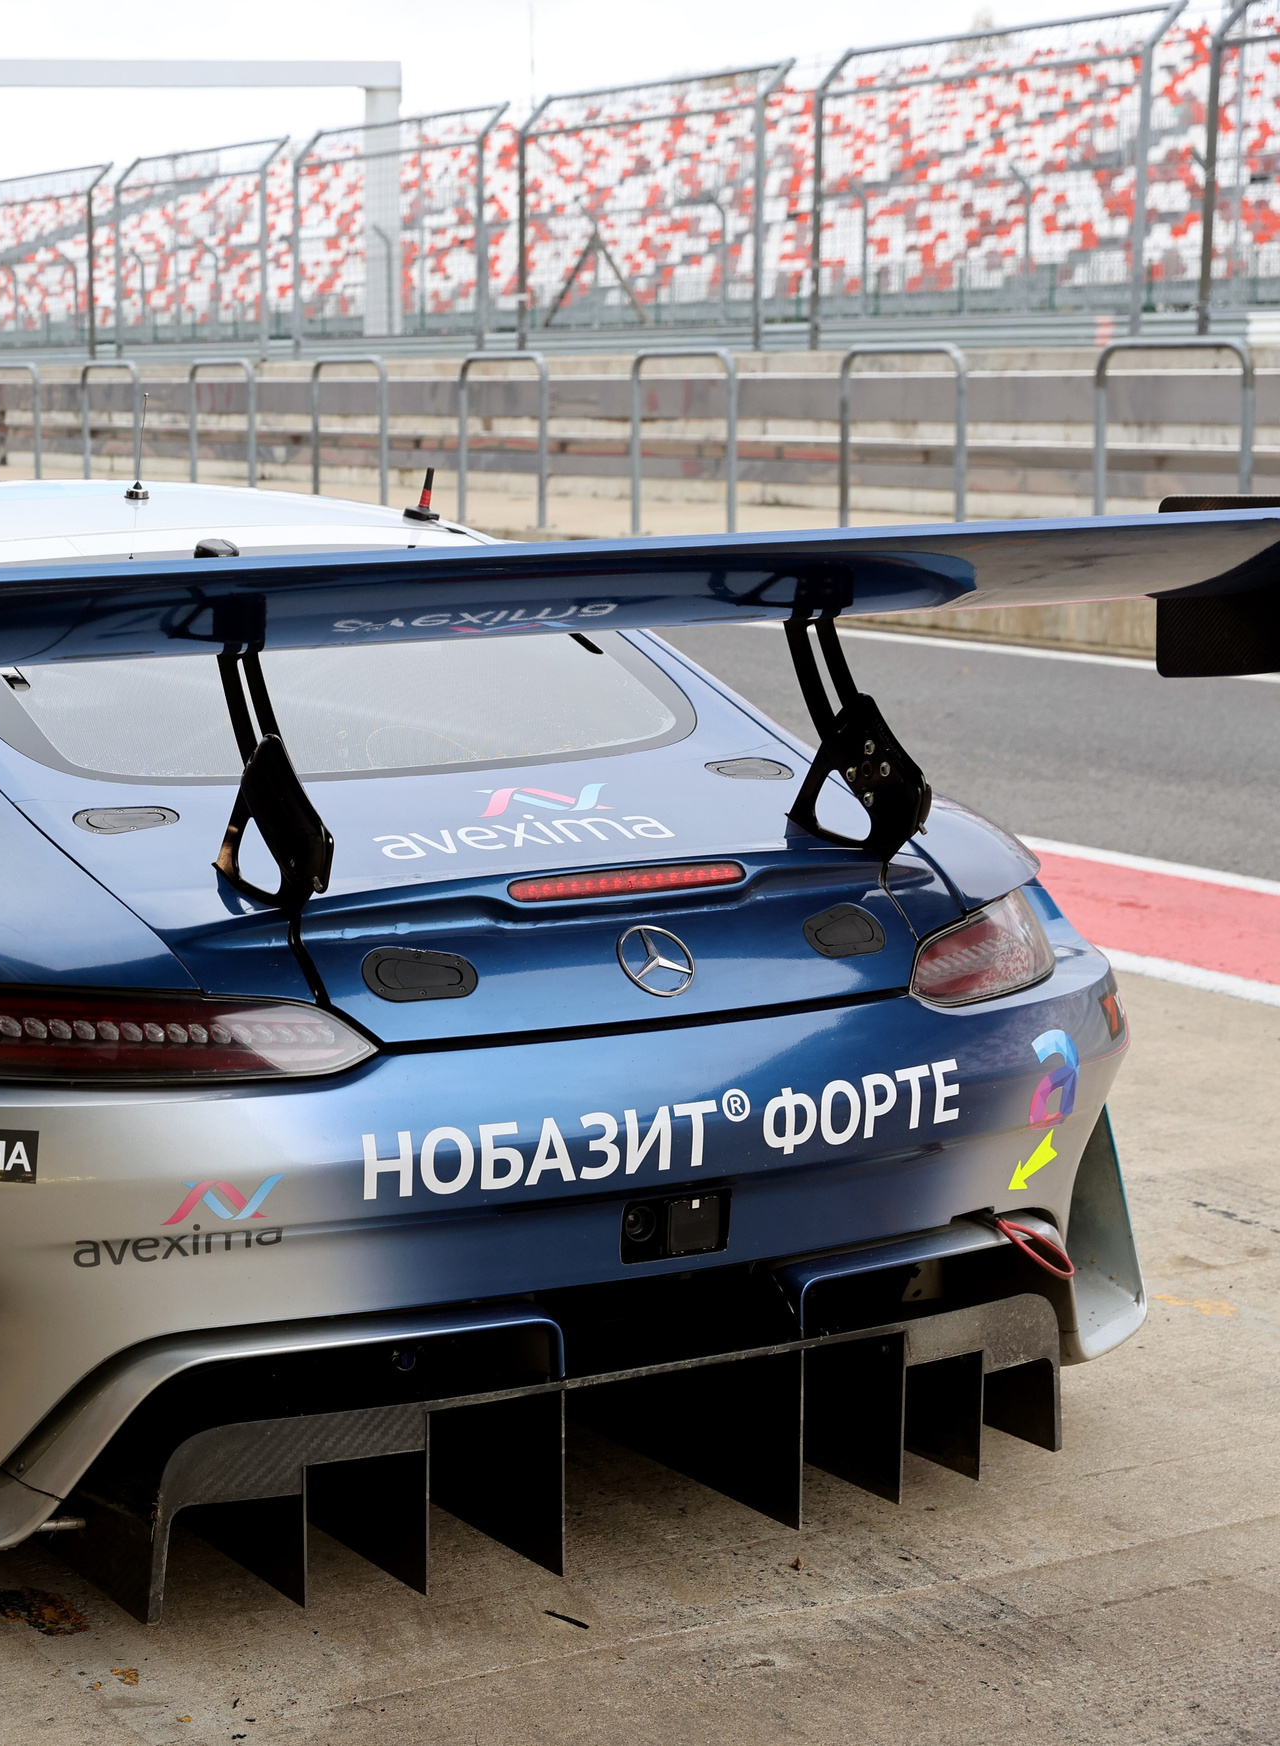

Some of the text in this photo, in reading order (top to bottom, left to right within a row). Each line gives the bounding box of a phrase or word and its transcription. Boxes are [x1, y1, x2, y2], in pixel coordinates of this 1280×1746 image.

[372, 814, 676, 860] avexima
[762, 1059, 960, 1155] ФОРТЕ
[73, 1223, 283, 1268] avexima
